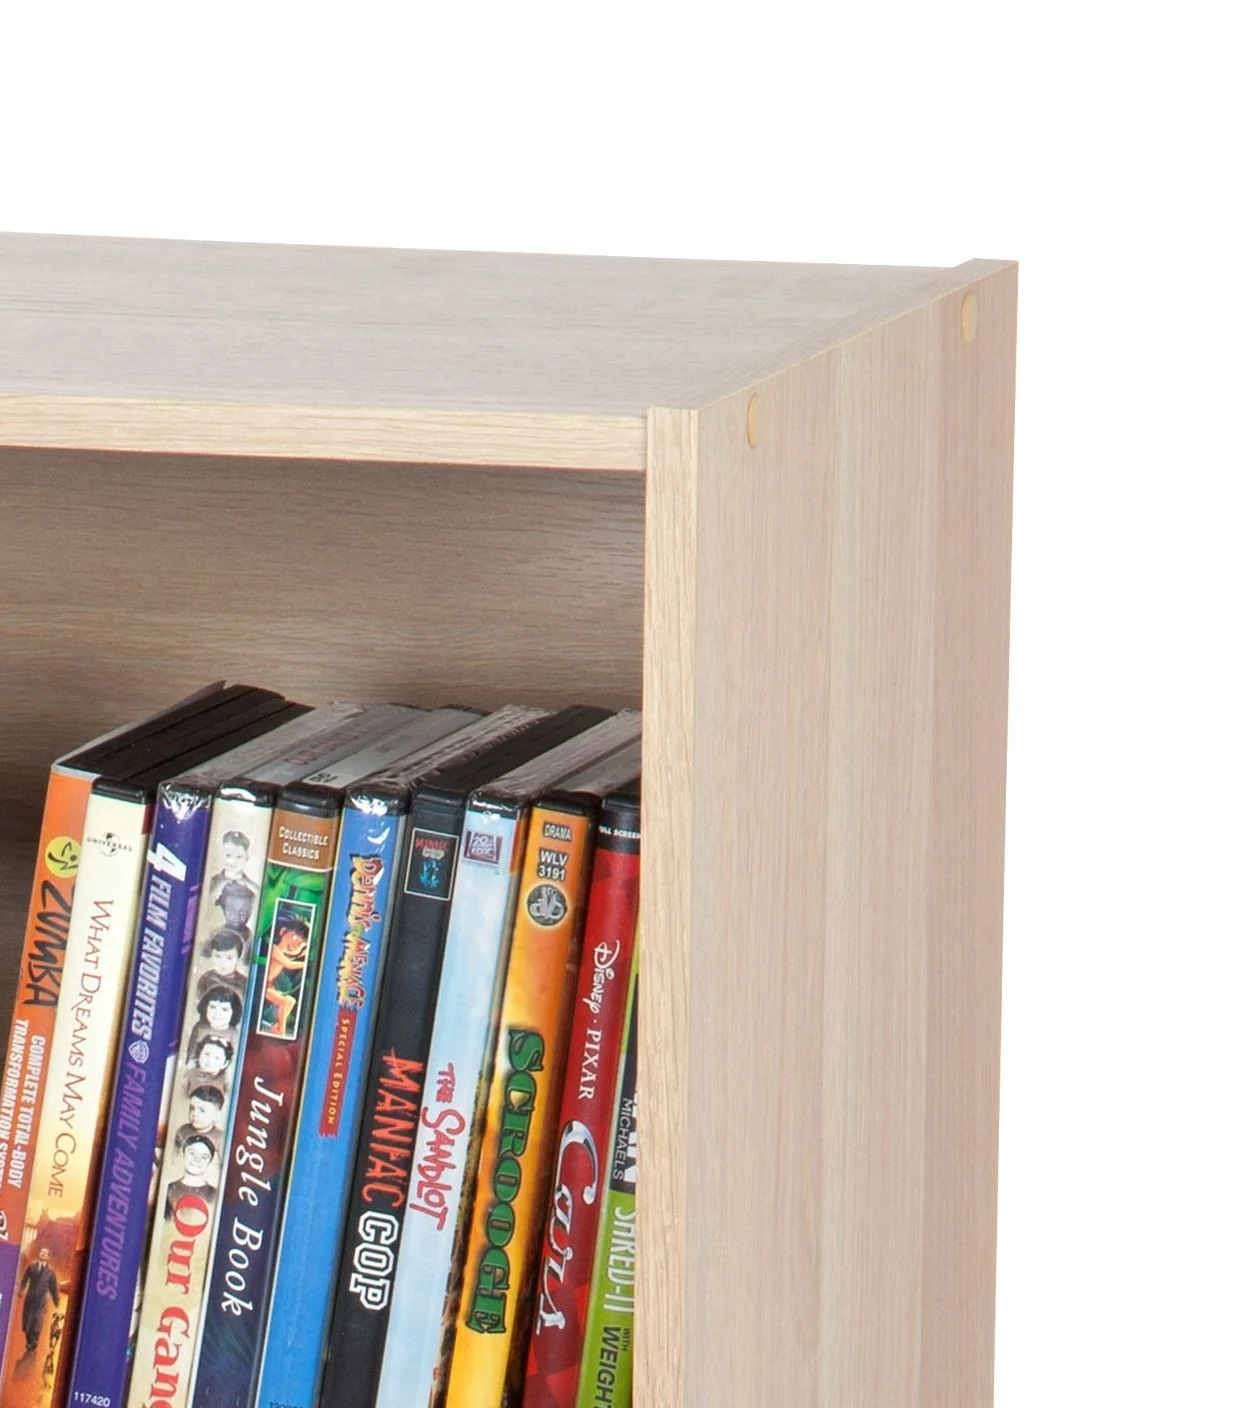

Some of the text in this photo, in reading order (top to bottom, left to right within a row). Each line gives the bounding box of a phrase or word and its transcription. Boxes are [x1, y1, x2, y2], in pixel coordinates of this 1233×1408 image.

[86, 836, 133, 853] UNIVERSAL
[147, 843, 187, 882] 4
[278, 825, 330, 847] COLLECTIBLE
[282, 842, 320, 861] CLASSICS
[538, 848, 568, 865] WLV
[543, 821, 573, 842] DRAMA
[145, 875, 172, 931] FILM
[537, 865, 567, 882] 3191
[23, 879, 72, 1007] ZUMBA
[131, 928, 166, 1041] FAVORITES
[327, 1018, 351, 1125] SPECIAL EDITION
[435, 1062, 456, 1104] THE
[578, 1028, 603, 1100] PIXAR
[8, 1035, 46, 1189] COMPLETE TOTAL-BODY
[117, 1062, 147, 1150] FAMILY
[613, 1098, 633, 1181] MICHAELS
[221, 1076, 284, 1317] Jungle Book
[349, 1048, 426, 1311] MANIAC COP
[465, 1028, 546, 1335] SCROOGE
[96, 1148, 135, 1300] ADVENTURES
[166, 1194, 210, 1296] Our
[536, 1119, 600, 1337] Cars
[73, 1391, 111, 1408] 117420
